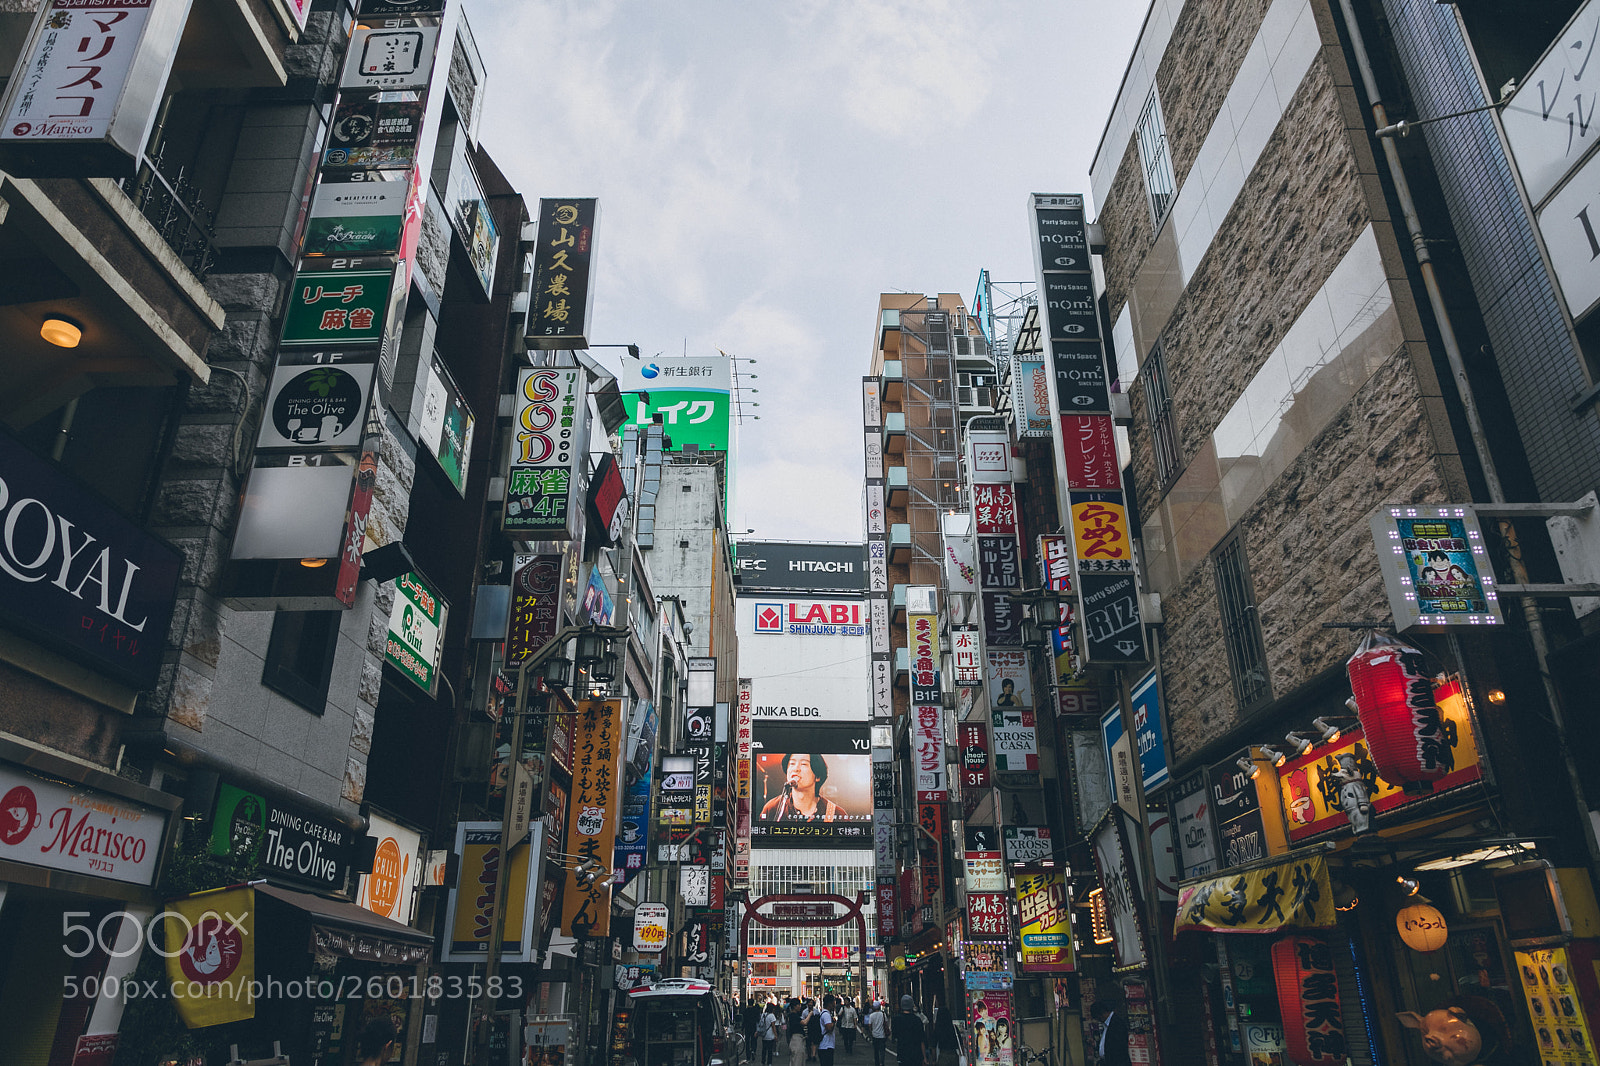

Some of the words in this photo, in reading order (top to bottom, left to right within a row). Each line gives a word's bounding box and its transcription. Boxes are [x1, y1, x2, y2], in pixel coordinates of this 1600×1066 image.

[49, 11, 129, 118] マリスコ
[32, 121, 93, 137] Marisco
[1058, 218, 1079, 226] Space
[331, 258, 363, 269] 2F
[543, 227, 575, 323] 山久農場
[302, 284, 364, 304] リーチ
[1066, 283, 1088, 291] Space
[319, 308, 375, 330] 麻雀
[544, 326, 566, 336] 5F
[313, 353, 344, 364] 1F
[1057, 353, 1076, 361] Party
[1076, 352, 1098, 361] Space
[663, 366, 714, 377] 新生銀行
[287, 404, 309, 416] The
[312, 404, 346, 415] Olive
[636, 400, 715, 425] レイク
[287, 454, 323, 467] B1
[1078, 415, 1100, 488] リフレッシュ
[508, 468, 572, 496] 麻雀
[533, 496, 566, 517] 4F
[1078, 503, 1123, 559] らーめん
[517, 556, 531, 564] 3F
[789, 560, 853, 573] HITACHI
[983, 550, 1000, 586] ルーム
[1000, 538, 1015, 587] レンタル
[1078, 560, 1132, 572] 博多天神
[1083, 588, 1105, 606] Party
[1103, 578, 1131, 599] Space
[788, 603, 859, 624] LABI
[81, 615, 141, 658] ロイヤル
[519, 595, 538, 661] カリーナ
[789, 625, 837, 635] SHINJUKU
[956, 633, 973, 666] 赤門
[877, 674, 890, 716] すずや
[914, 689, 939, 701] B1F
[738, 690, 751, 753] お好み焼き
[790, 706, 822, 719] BLDG.
[995, 731, 1035, 742] XROSS
[1000, 740, 1032, 751] CASA
[968, 772, 984, 786] 3F
[696, 785, 709, 810] 麻雀
[924, 791, 940, 801] 4F
[269, 808, 302, 832] DINING
[695, 810, 709, 821] 2F
[40, 807, 147, 864] Marisco
[1008, 839, 1049, 850] XROSS
[265, 827, 296, 869] The
[296, 840, 338, 884] Olive
[1013, 849, 1044, 860] CASA
[88, 858, 115, 874] マリスコ
[374, 855, 399, 879] CHILL
[1019, 883, 1064, 925] 出会い
[1039, 907, 1068, 933] カフェ
[809, 946, 849, 960] LABI
